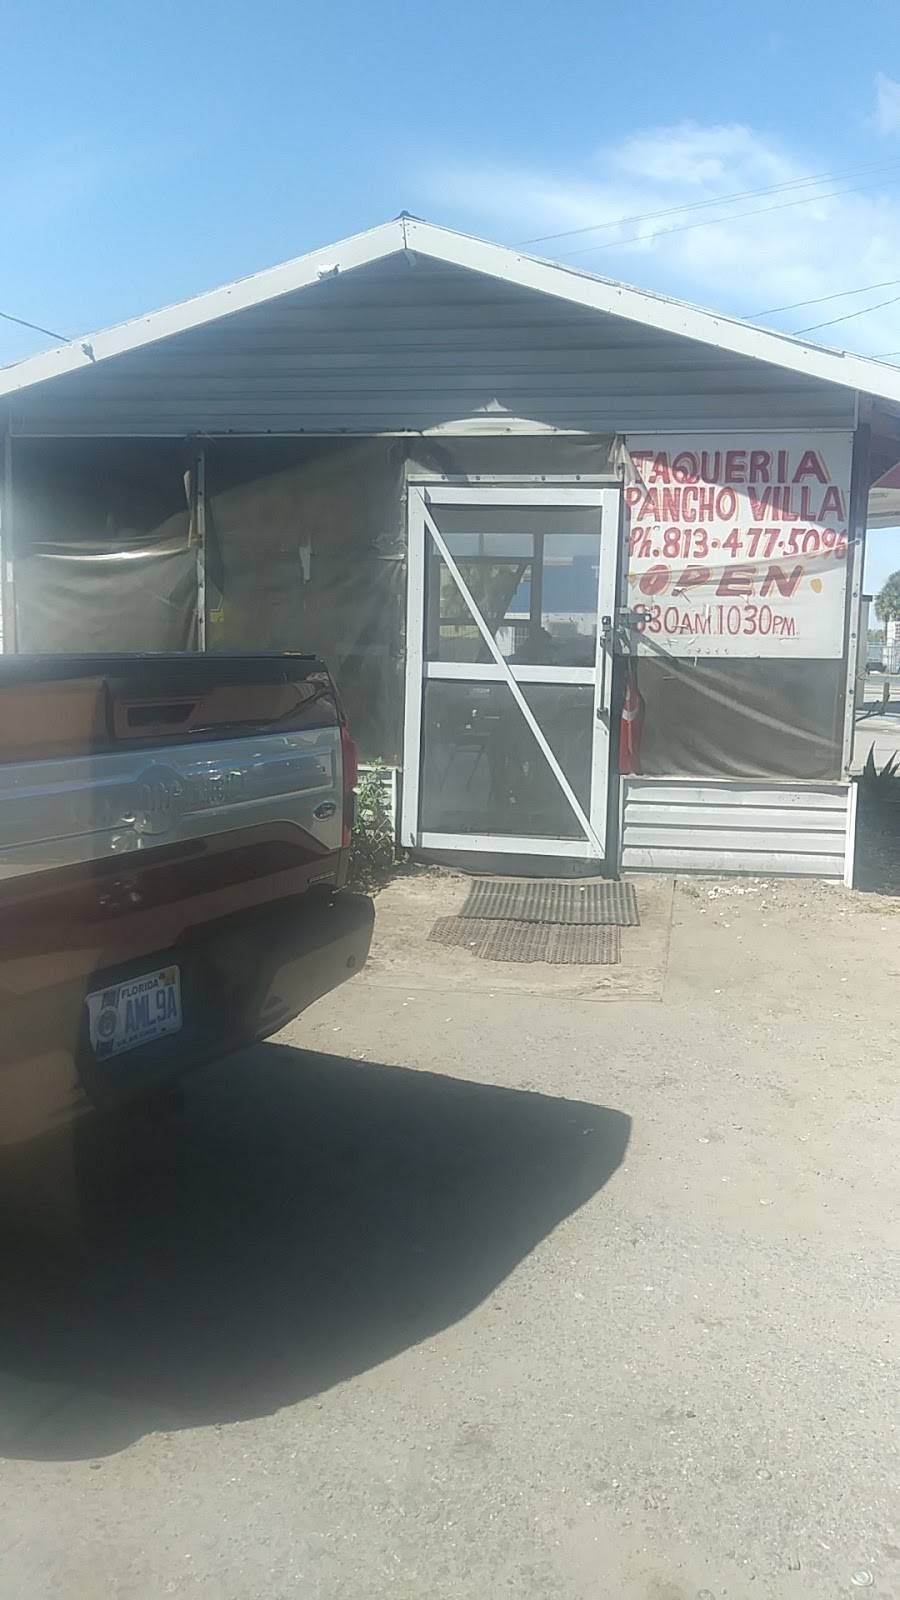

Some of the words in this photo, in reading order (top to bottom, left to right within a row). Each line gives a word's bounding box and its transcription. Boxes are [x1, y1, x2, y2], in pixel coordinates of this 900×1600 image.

[630, 450, 828, 484] TAQUERIA
[625, 486, 738, 522] PANCHO
[747, 486, 845, 522] VILLA
[639, 564, 803, 597] OPEN
[121, 978, 160, 1000] FLORIDA
